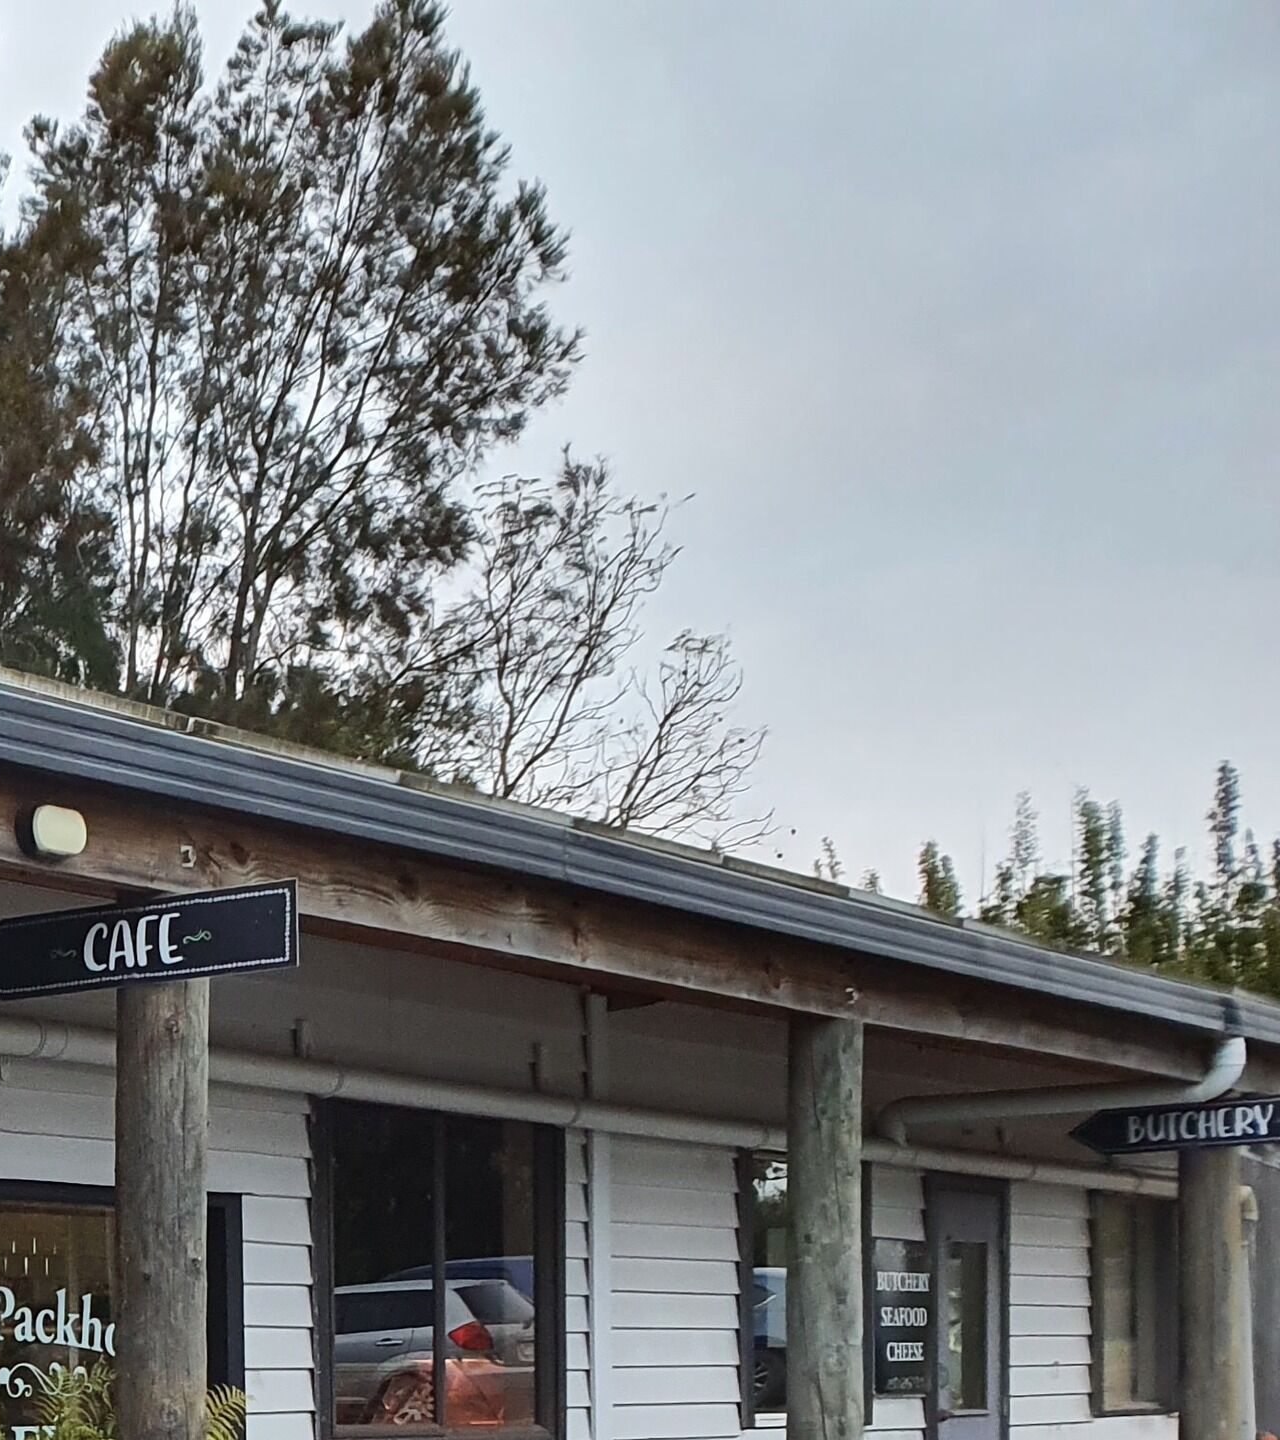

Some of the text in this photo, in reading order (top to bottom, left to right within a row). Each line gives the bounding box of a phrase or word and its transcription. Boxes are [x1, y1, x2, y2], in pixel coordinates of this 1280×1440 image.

[82, 912, 184, 972] CAFE
[1127, 1103, 1274, 1144] BUTCHERY
[876, 1271, 930, 1293] BUTCHERY
[880, 1306, 928, 1327] SEAFOOD
[886, 1342, 925, 1362] CHEESE
